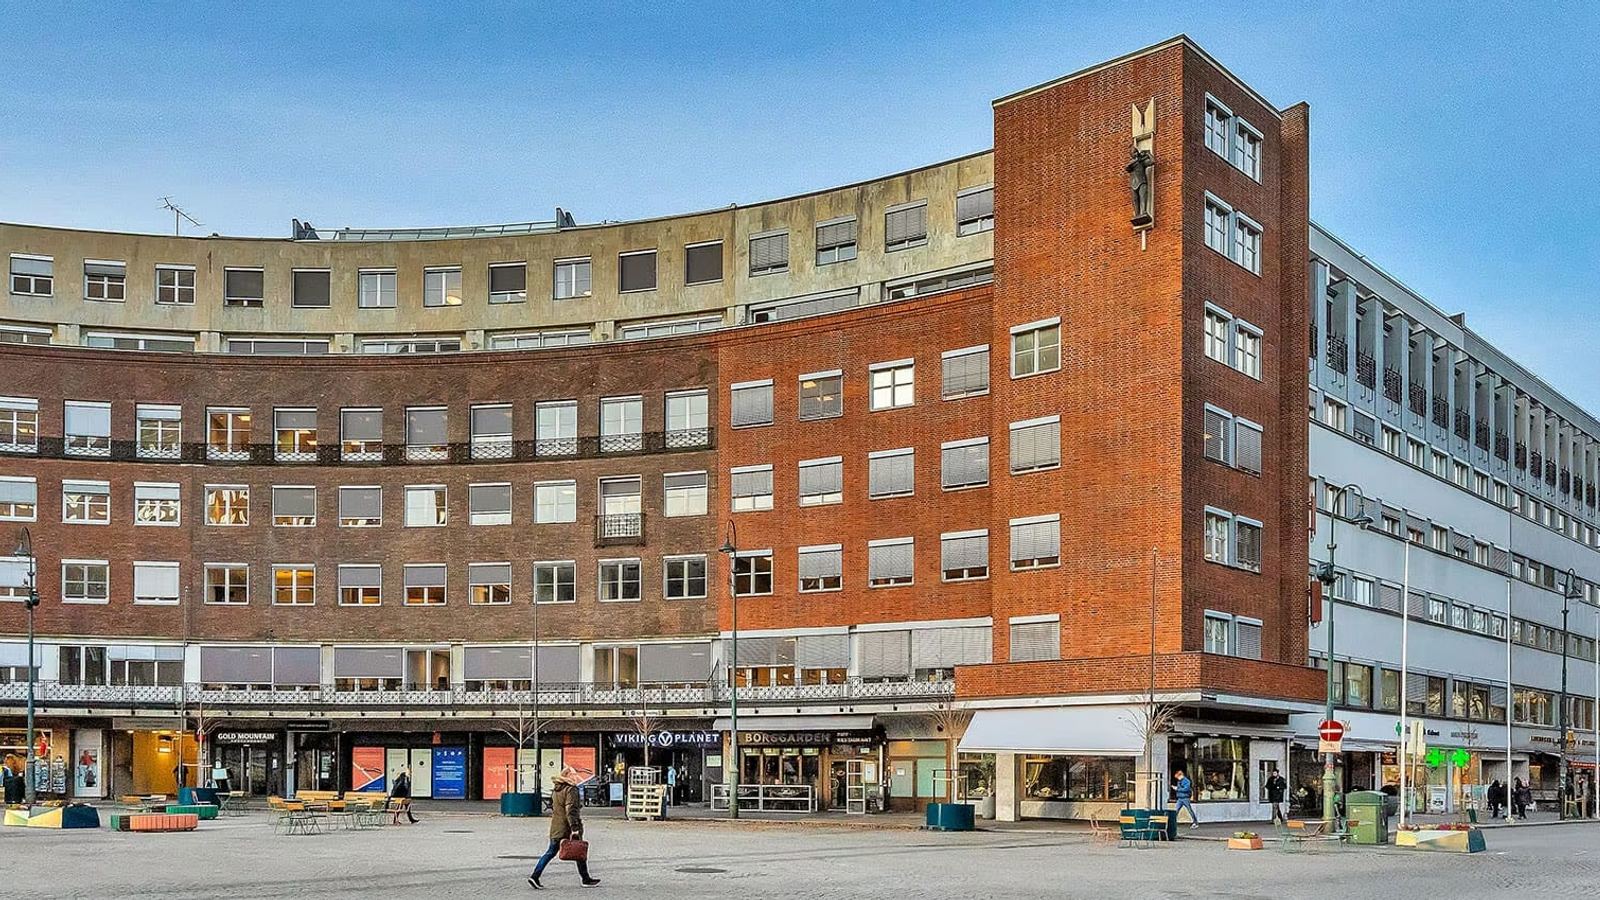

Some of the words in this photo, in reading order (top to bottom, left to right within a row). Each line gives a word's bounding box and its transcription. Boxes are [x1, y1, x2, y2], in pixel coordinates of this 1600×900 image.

[217, 732, 237, 740] GOLD
[237, 732, 275, 740] MOUNTAIN
[616, 734, 656, 743] VIKING
[674, 733, 719, 743] PLANET
